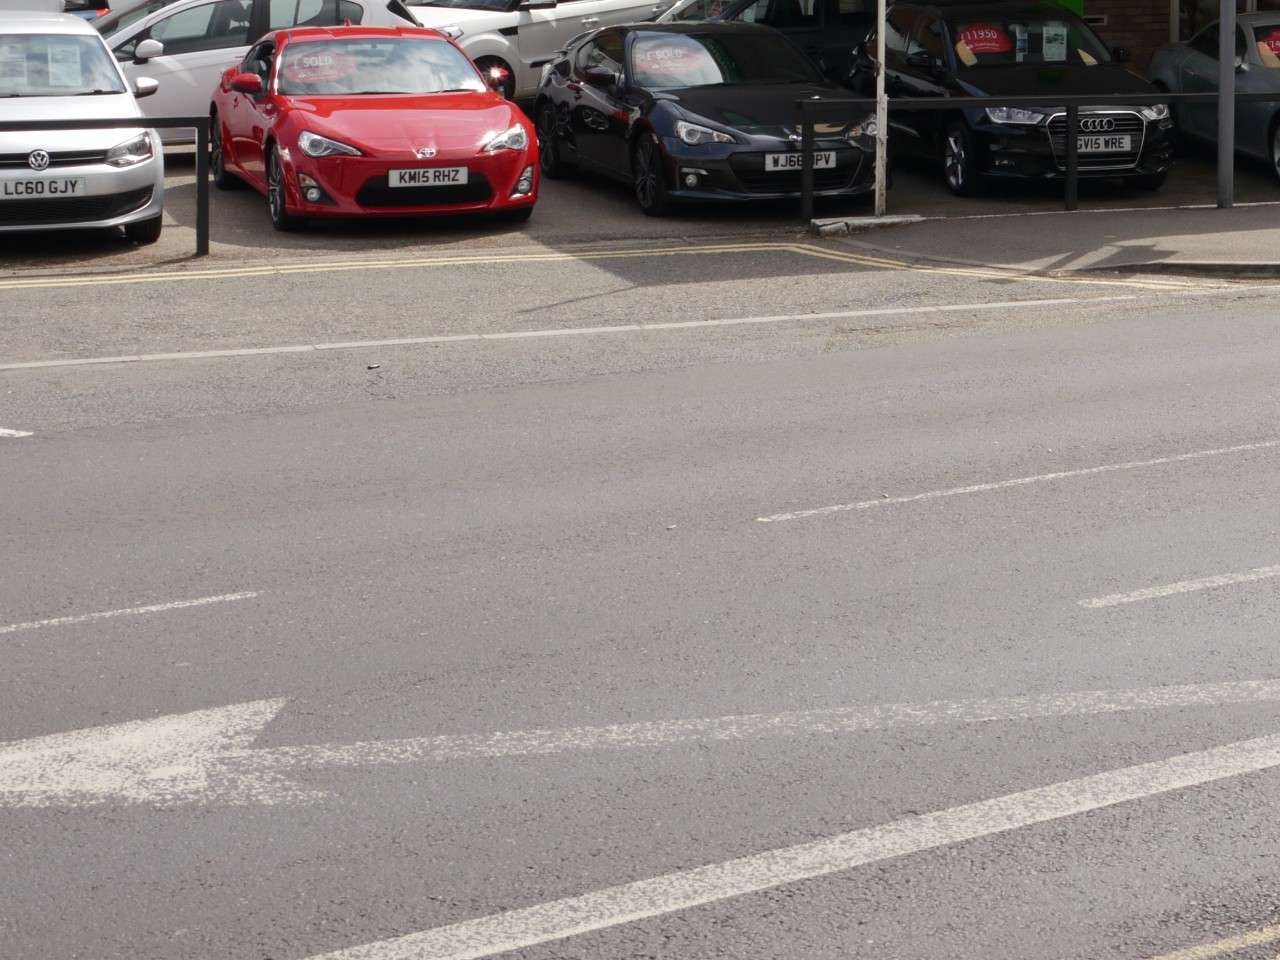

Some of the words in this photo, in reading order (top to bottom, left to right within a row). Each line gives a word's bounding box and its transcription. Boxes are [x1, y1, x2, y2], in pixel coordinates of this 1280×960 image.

[303, 55, 333, 68] SOLD
[1103, 137, 1125, 149] WRE
[399, 171, 430, 184] KM15
[433, 169, 460, 182] RHZ
[4, 180, 44, 195] LC60
[48, 180, 78, 194] GJY
